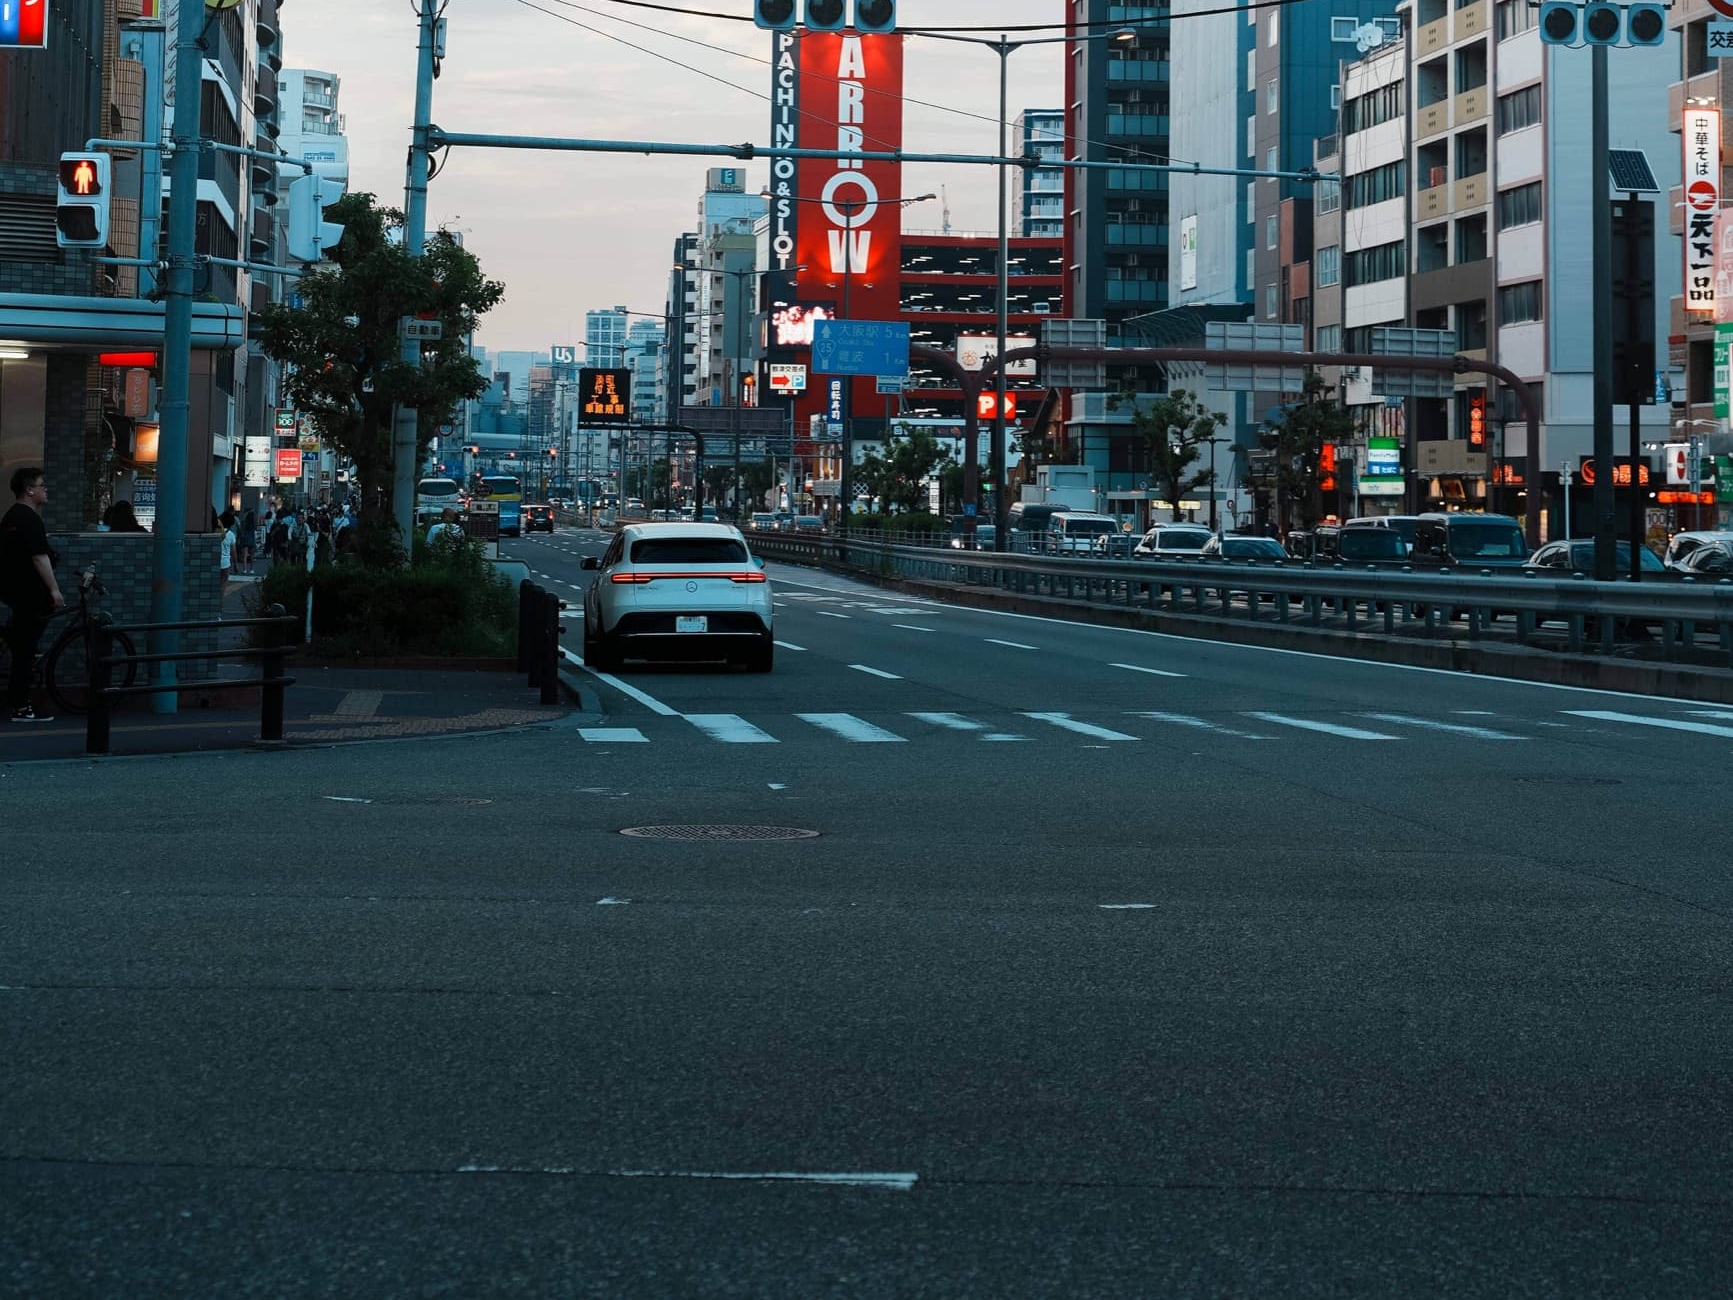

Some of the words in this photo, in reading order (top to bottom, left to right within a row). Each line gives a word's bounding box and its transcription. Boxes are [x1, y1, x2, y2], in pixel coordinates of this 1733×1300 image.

[821, 37, 878, 273] ARROW
[1695, 118, 1709, 176] 中華そば
[1690, 213, 1714, 300] 天下一品
[820, 343, 831, 352] 25
[839, 325, 879, 338] 大阪駅
[885, 326, 892, 338] 5
[979, 395, 995, 414] P
